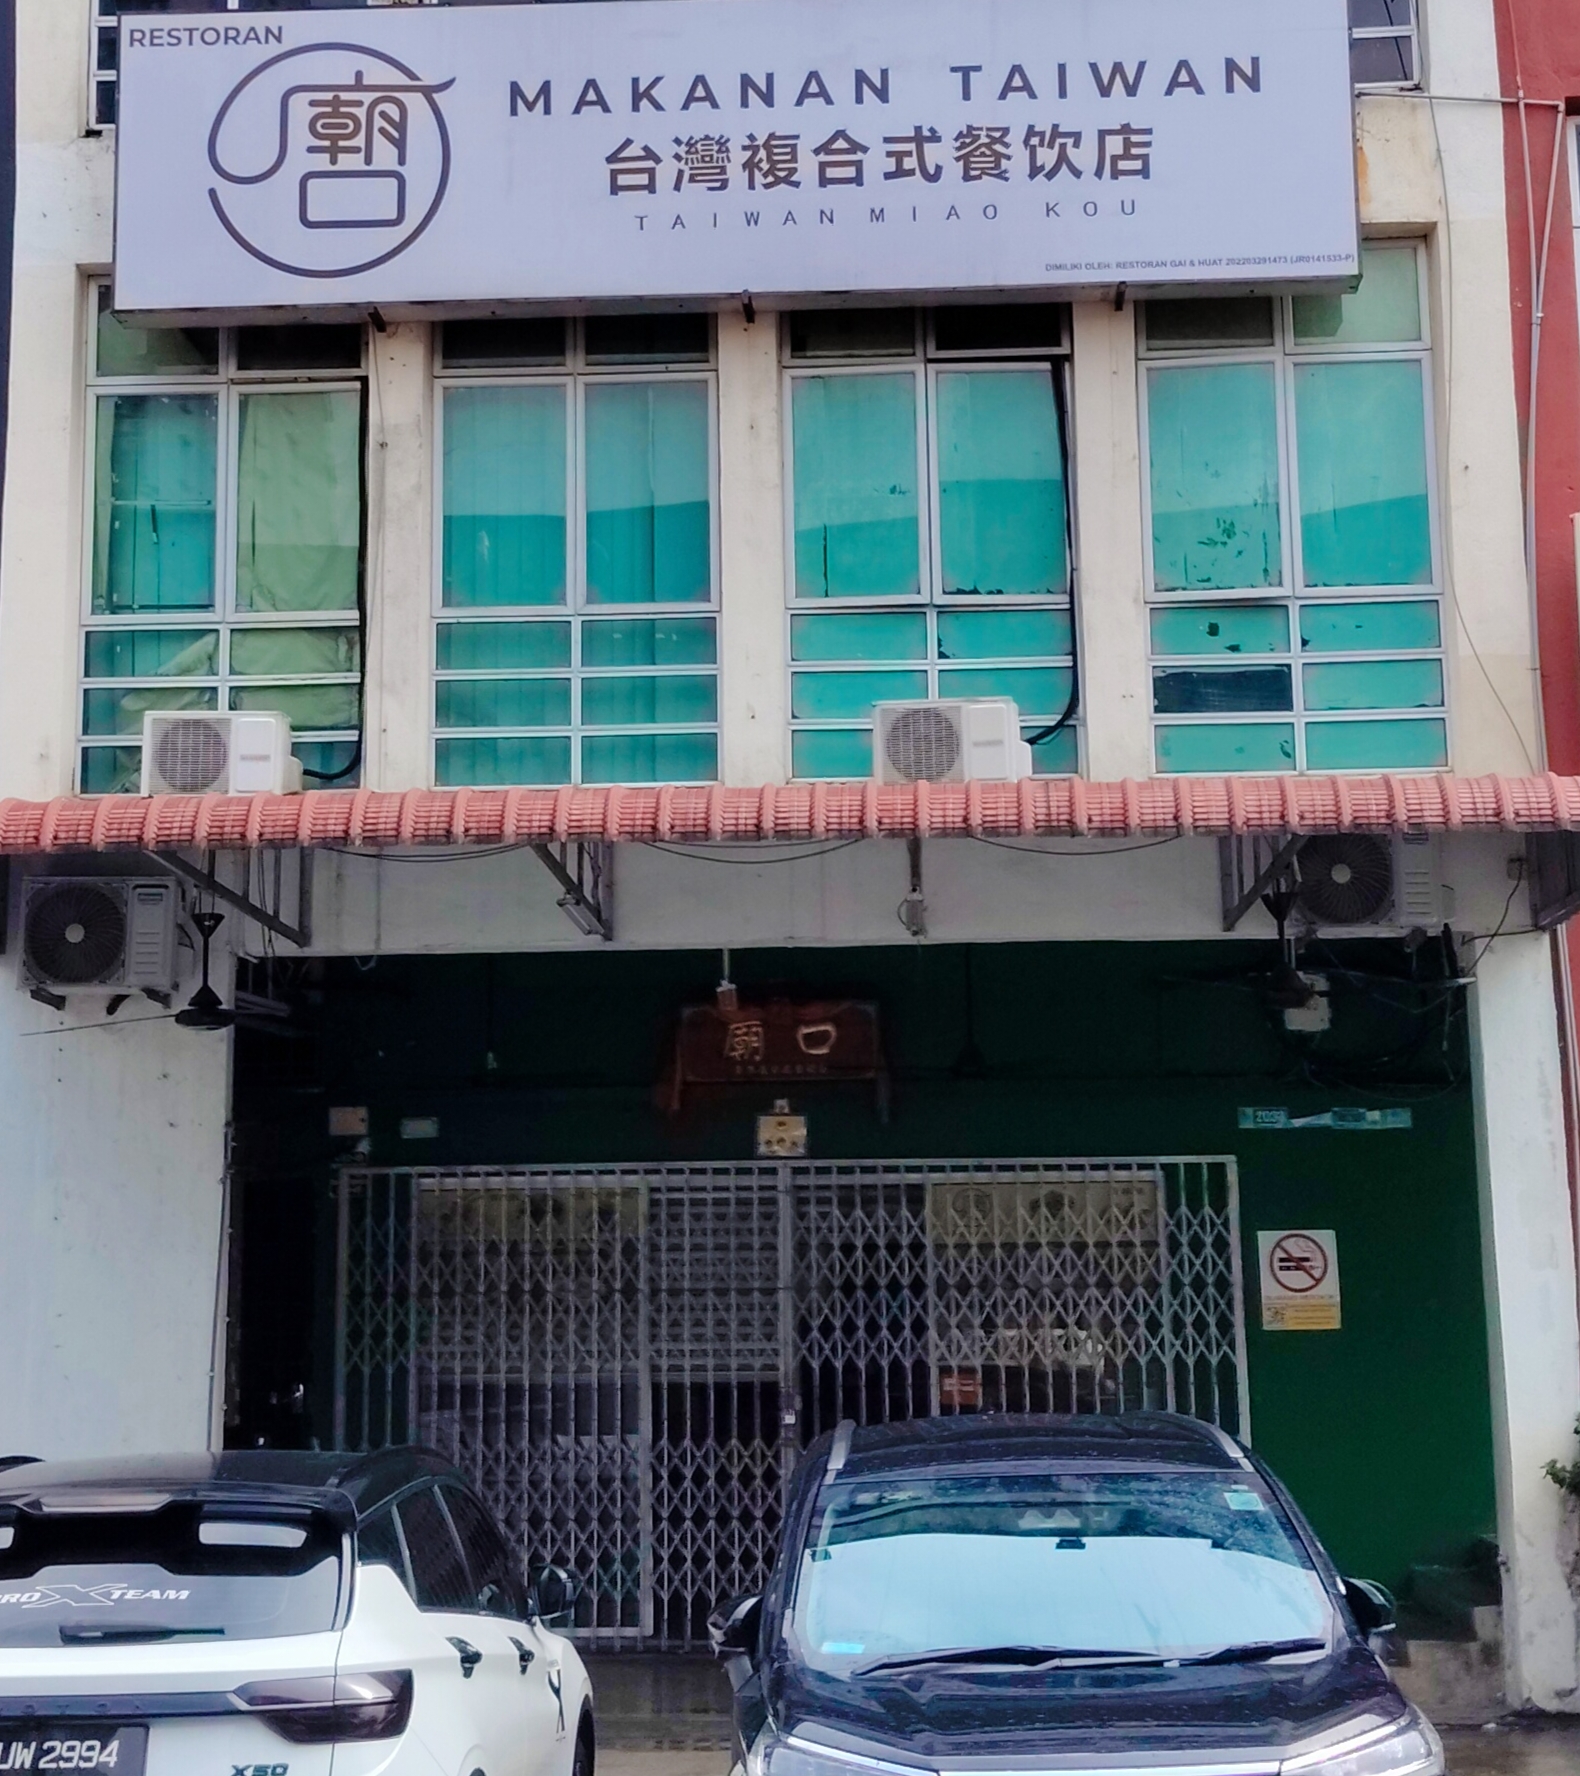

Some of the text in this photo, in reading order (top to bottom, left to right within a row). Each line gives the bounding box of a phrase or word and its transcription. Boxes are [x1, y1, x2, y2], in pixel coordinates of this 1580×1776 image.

[129, 25, 283, 48] RESTORAN
[509, 56, 1261, 117] MAKANAN TAIWAN
[604, 124, 1154, 197] 台灣複合式餐饮店
[634, 199, 1135, 231] TAIWAN MIAO KOU
[1045, 262, 1082, 272] DIMILIKI
[1115, 259, 1167, 270] RESTORAN
[1169, 259, 1187, 268] GAI
[1197, 258, 1223, 267] HUAT
[0, 1592, 42, 1604] RO
[110, 1589, 191, 1600] TEAM
[38, 1739, 120, 1769] 2994
